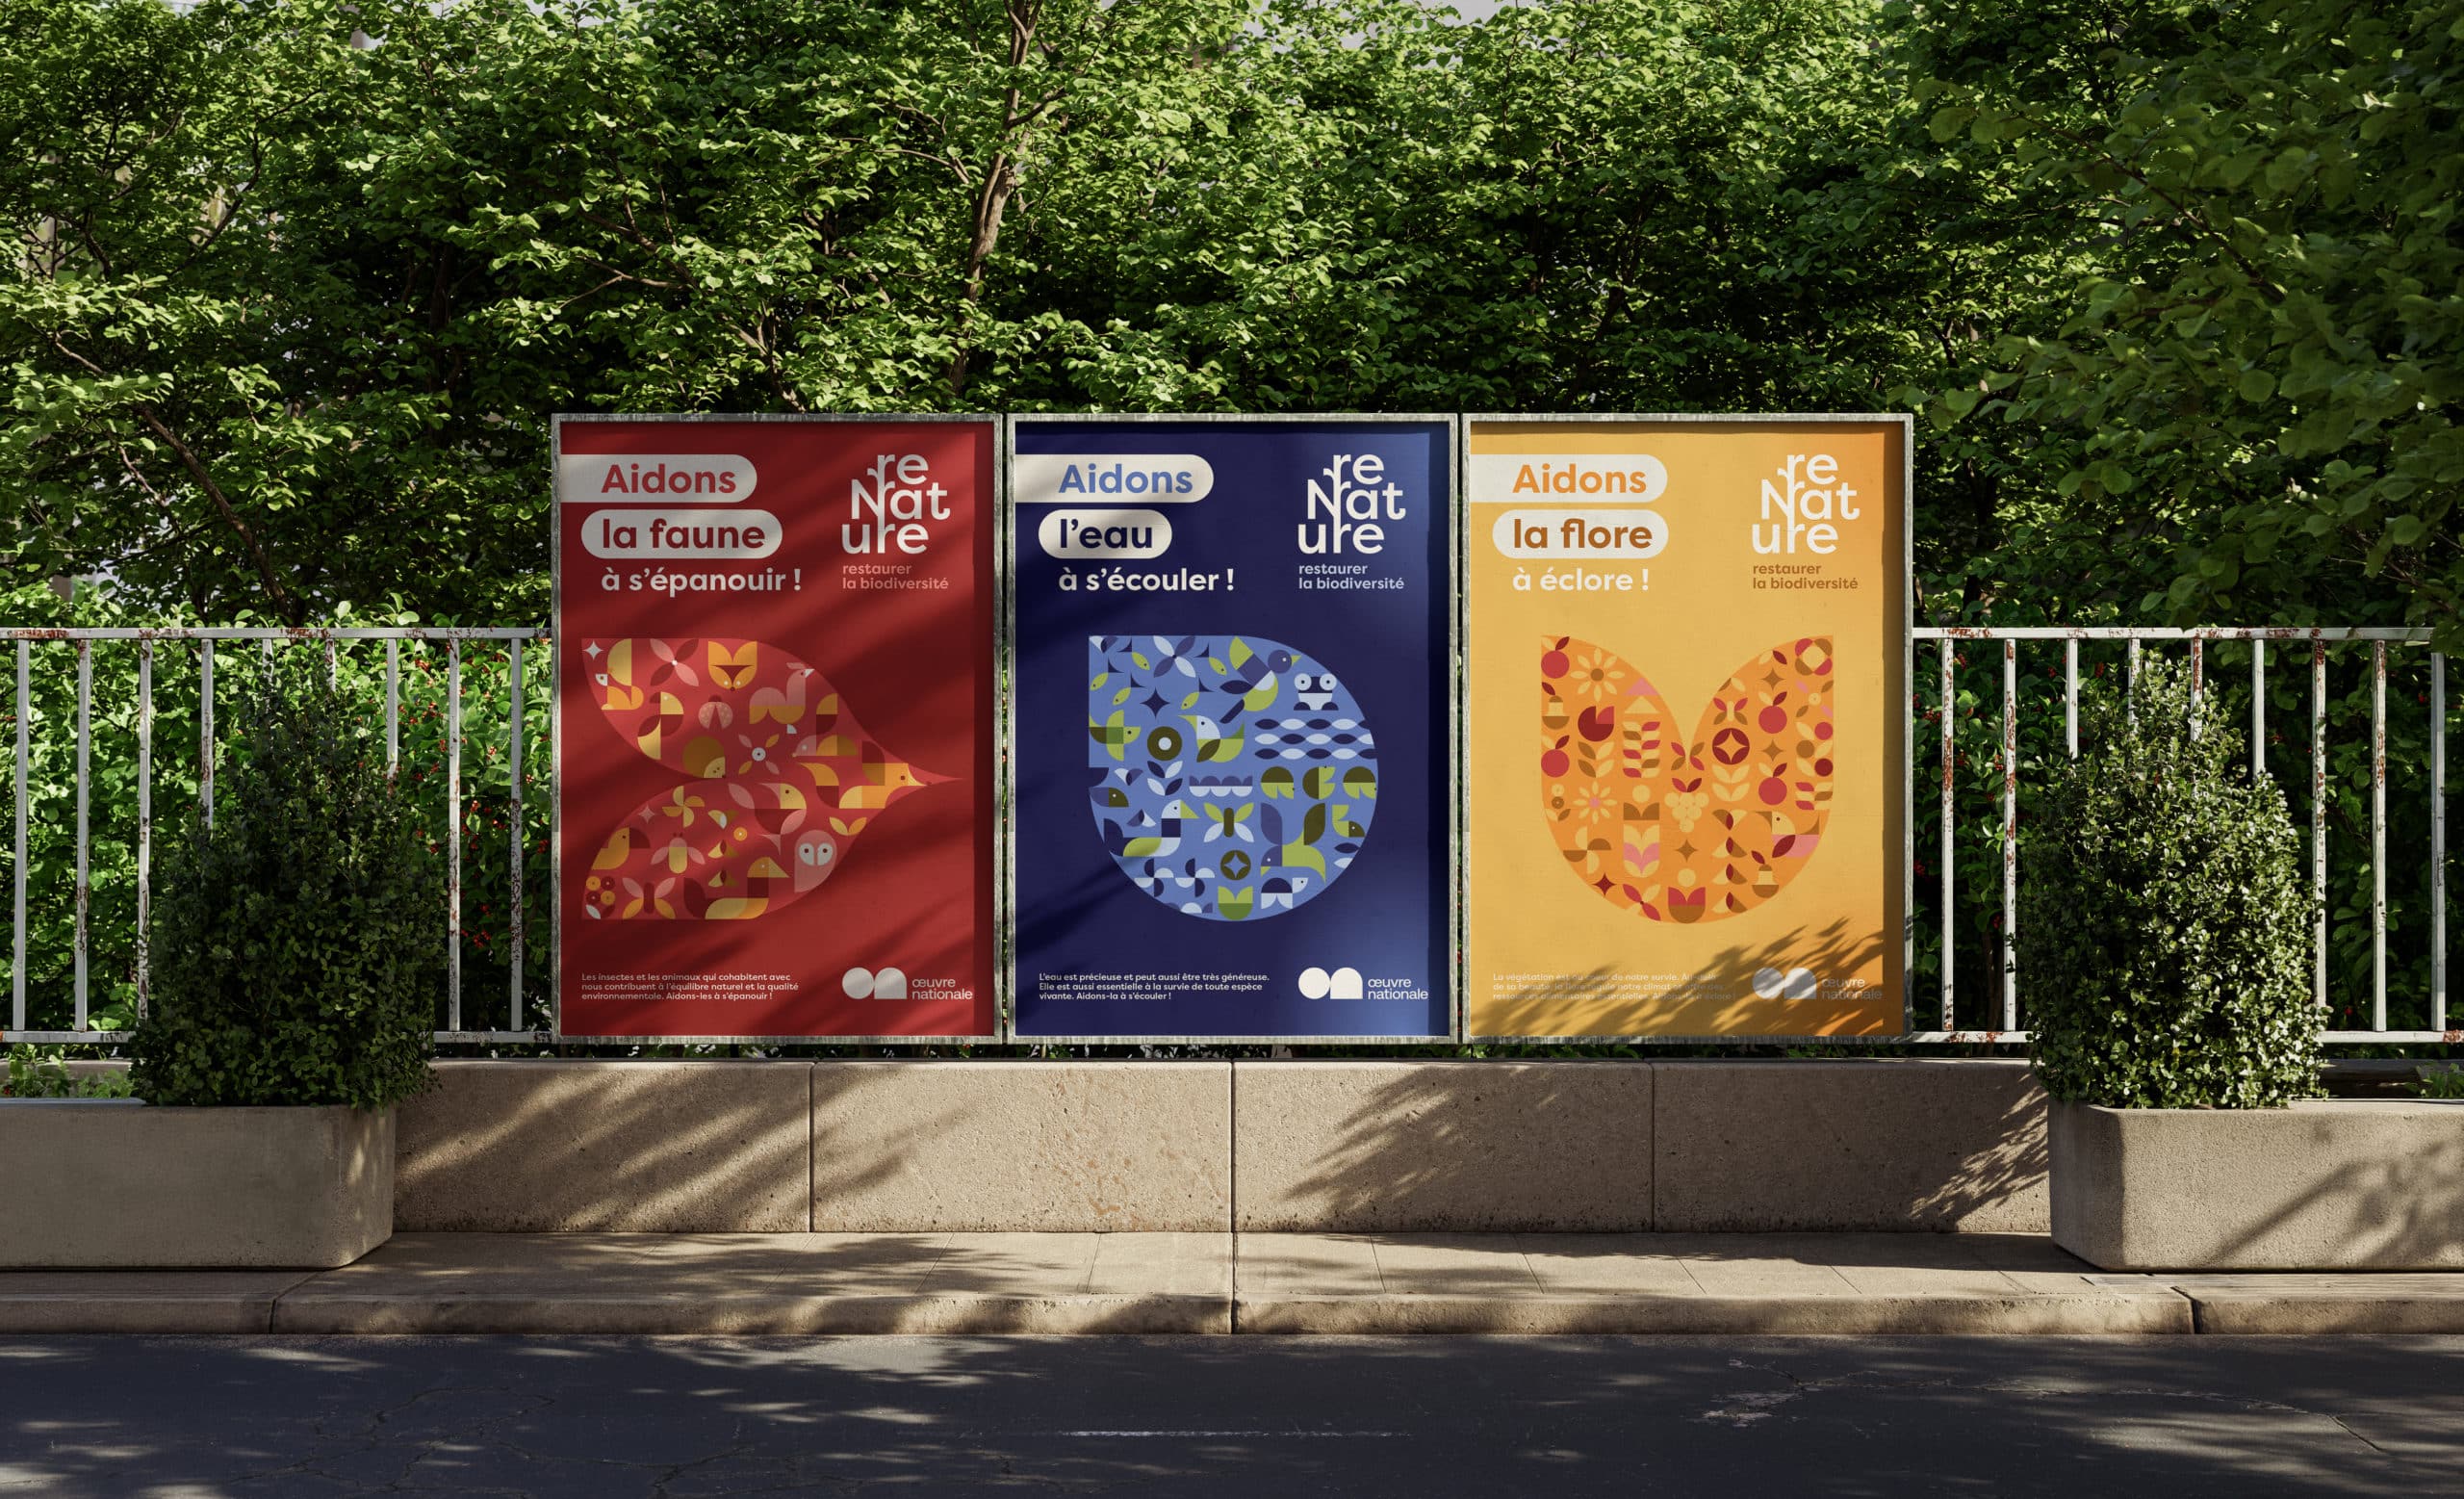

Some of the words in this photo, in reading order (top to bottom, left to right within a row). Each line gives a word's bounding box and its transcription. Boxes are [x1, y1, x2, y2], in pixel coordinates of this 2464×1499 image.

[876, 453, 928, 484] re
[1332, 453, 1384, 484] re
[1786, 453, 1838, 484] re
[601, 463, 737, 494] Aidons
[1059, 463, 1194, 494] Aidons
[1512, 463, 1647, 494] Aidons
[851, 478, 950, 520] Nat
[1307, 478, 1406, 520] Nat
[1760, 478, 1861, 520] Nat
[602, 518, 637, 549] la
[650, 517, 766, 549] faune
[841, 523, 929, 554] ure
[1060, 517, 1153, 549] l’eau
[1297, 523, 1385, 554] ure
[1513, 518, 1548, 549] la
[1560, 517, 1653, 549] flore
[1752, 523, 1838, 554] ure
[842, 563, 911, 576] restaurer
[1059, 566, 1077, 591] à
[1086, 567, 1219, 591] s’écouler
[1226, 568, 1235, 591] !
[1298, 563, 1368, 576] restaurer
[1512, 566, 1531, 591] à
[1540, 566, 1633, 591] éclore
[1642, 568, 1650, 591] !
[1752, 563, 1822, 576] restaurer
[601, 566, 620, 591] à
[629, 567, 786, 598] s’épanouir
[793, 568, 802, 591] !
[842, 577, 858, 590] la
[860, 577, 949, 590] biodiversité
[1298, 577, 1314, 590] la
[1317, 577, 1404, 590] biodiversité
[1752, 577, 1767, 590] la
[1770, 577, 1859, 590] biodiversité
[581, 972, 597, 981] Les
[598, 972, 634, 981] insectes
[636, 972, 646, 981] et
[648, 972, 660, 981] les
[661, 972, 701, 981] animaux
[703, 972, 717, 983] qui
[718, 972, 767, 981] cohabitent
[769, 972, 791, 981] avec
[911, 978, 956, 988] œuvre
[1040, 972, 1062, 981] L’eau
[1064, 972, 1078, 981] est
[1079, 972, 1122, 983] précieuse
[1123, 972, 1134, 981] et
[1135, 972, 1156, 983] peut
[1158, 972, 1180, 981] aussi
[1182, 972, 1200, 981] être
[1202, 972, 1219, 981] très
[1221, 972, 1270, 983] généreuse.
[1368, 978, 1412, 988] œuvre
[1821, 978, 1865, 988] œuvre
[581, 982, 603, 991] nous
[604, 982, 656, 991] contribuent
[658, 982, 664, 991] à
[710, 982, 743, 991] naturel
[745, 982, 755, 991] et
[757, 982, 765, 991] la
[767, 982, 799, 993] qualité
[581, 992, 664, 1000] environnementale.
[666, 992, 712, 1000] Aidons-les
[714, 992, 720, 1000] à
[722, 992, 767, 1002] s’épanouir
[911, 988, 974, 1000] nationale
[1040, 982, 1054, 991] Elle
[1056, 982, 1070, 991] est
[1072, 982, 1094, 991] aussi
[1096, 982, 1142, 991] essentielle
[1144, 982, 1151, 991] à
[1152, 982, 1162, 991] la
[1163, 982, 1190, 991] survie
[1192, 982, 1203, 991] de
[1205, 982, 1229, 991] toute
[1231, 982, 1263, 993] espèce
[1040, 992, 1074, 1000] vivante.
[1076, 992, 1118, 1000] Aidons-la
[1120, 992, 1126, 1000] à
[1128, 992, 1167, 1000] s’écouler
[1368, 988, 1429, 1000] nationale
[1821, 988, 1883, 1000] nationale
